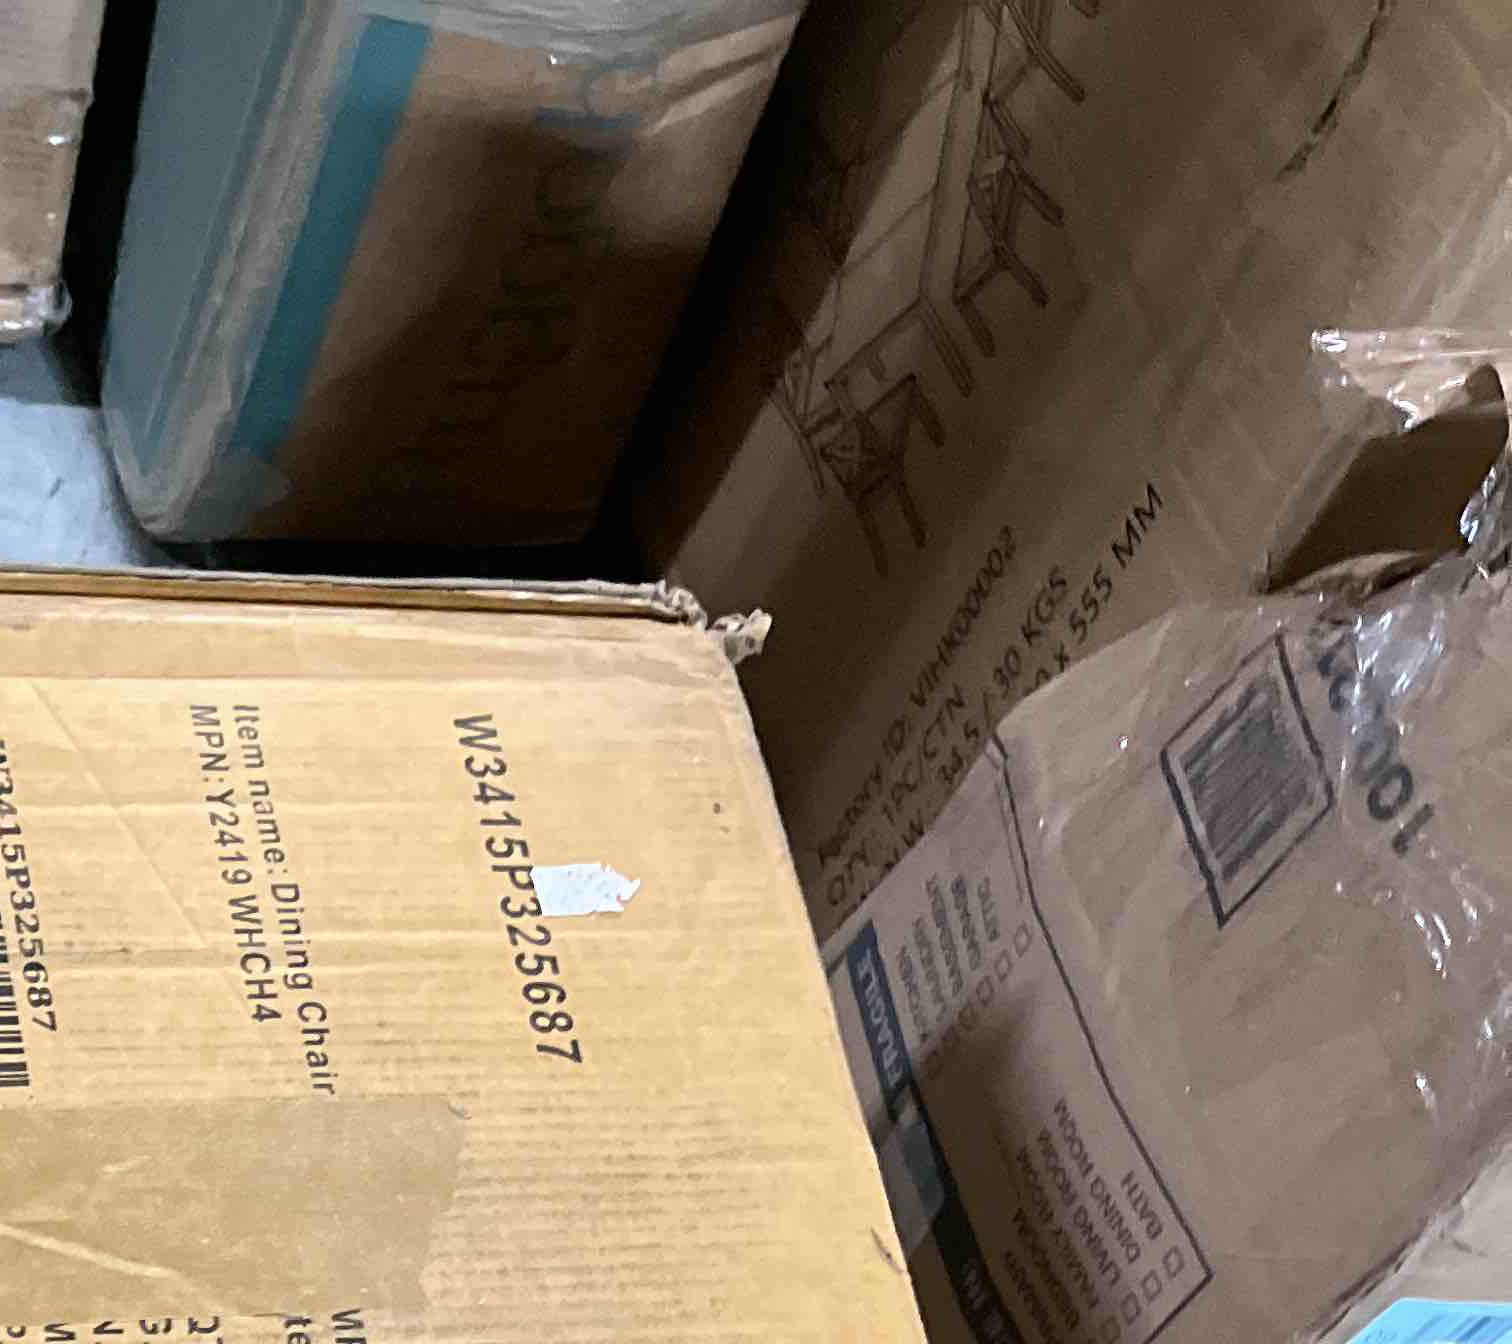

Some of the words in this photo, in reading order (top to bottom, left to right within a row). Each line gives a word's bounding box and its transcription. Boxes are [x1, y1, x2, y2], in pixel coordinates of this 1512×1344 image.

[1021, 564, 1067, 647] KGS
[1069, 560, 1113, 646] 555
[1112, 482, 1163, 569] MM
[232, 704, 265, 768] Item
[297, 1002, 339, 1095] Chair
[453, 712, 583, 1065] W3415P325687
[228, 896, 282, 1024] WHCH4
[1090, 1175, 1141, 1265] DINING
[1121, 1169, 1164, 1241] BATH
